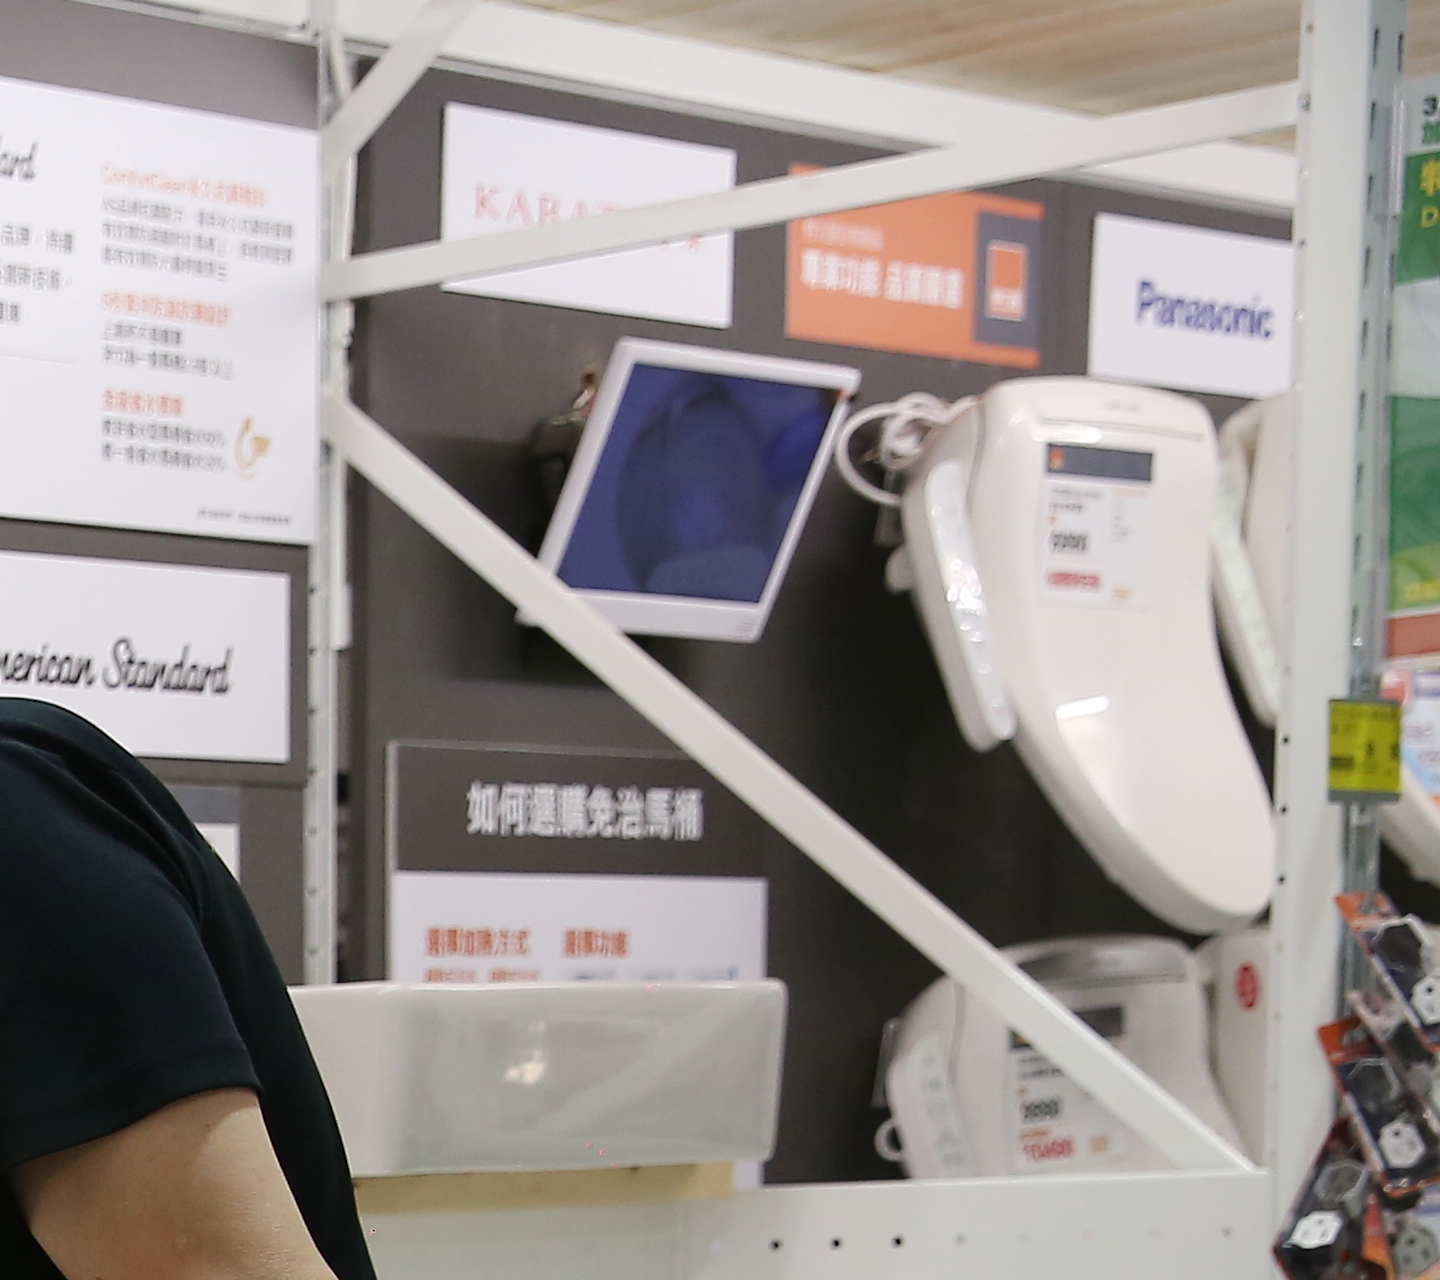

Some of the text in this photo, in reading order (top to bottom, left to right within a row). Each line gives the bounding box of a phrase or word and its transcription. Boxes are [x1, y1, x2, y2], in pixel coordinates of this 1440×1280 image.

[1136, 279, 1276, 339] Panasonic
[101, 638, 235, 697] Standard
[466, 779, 704, 841] 如何選購免治馬桶
